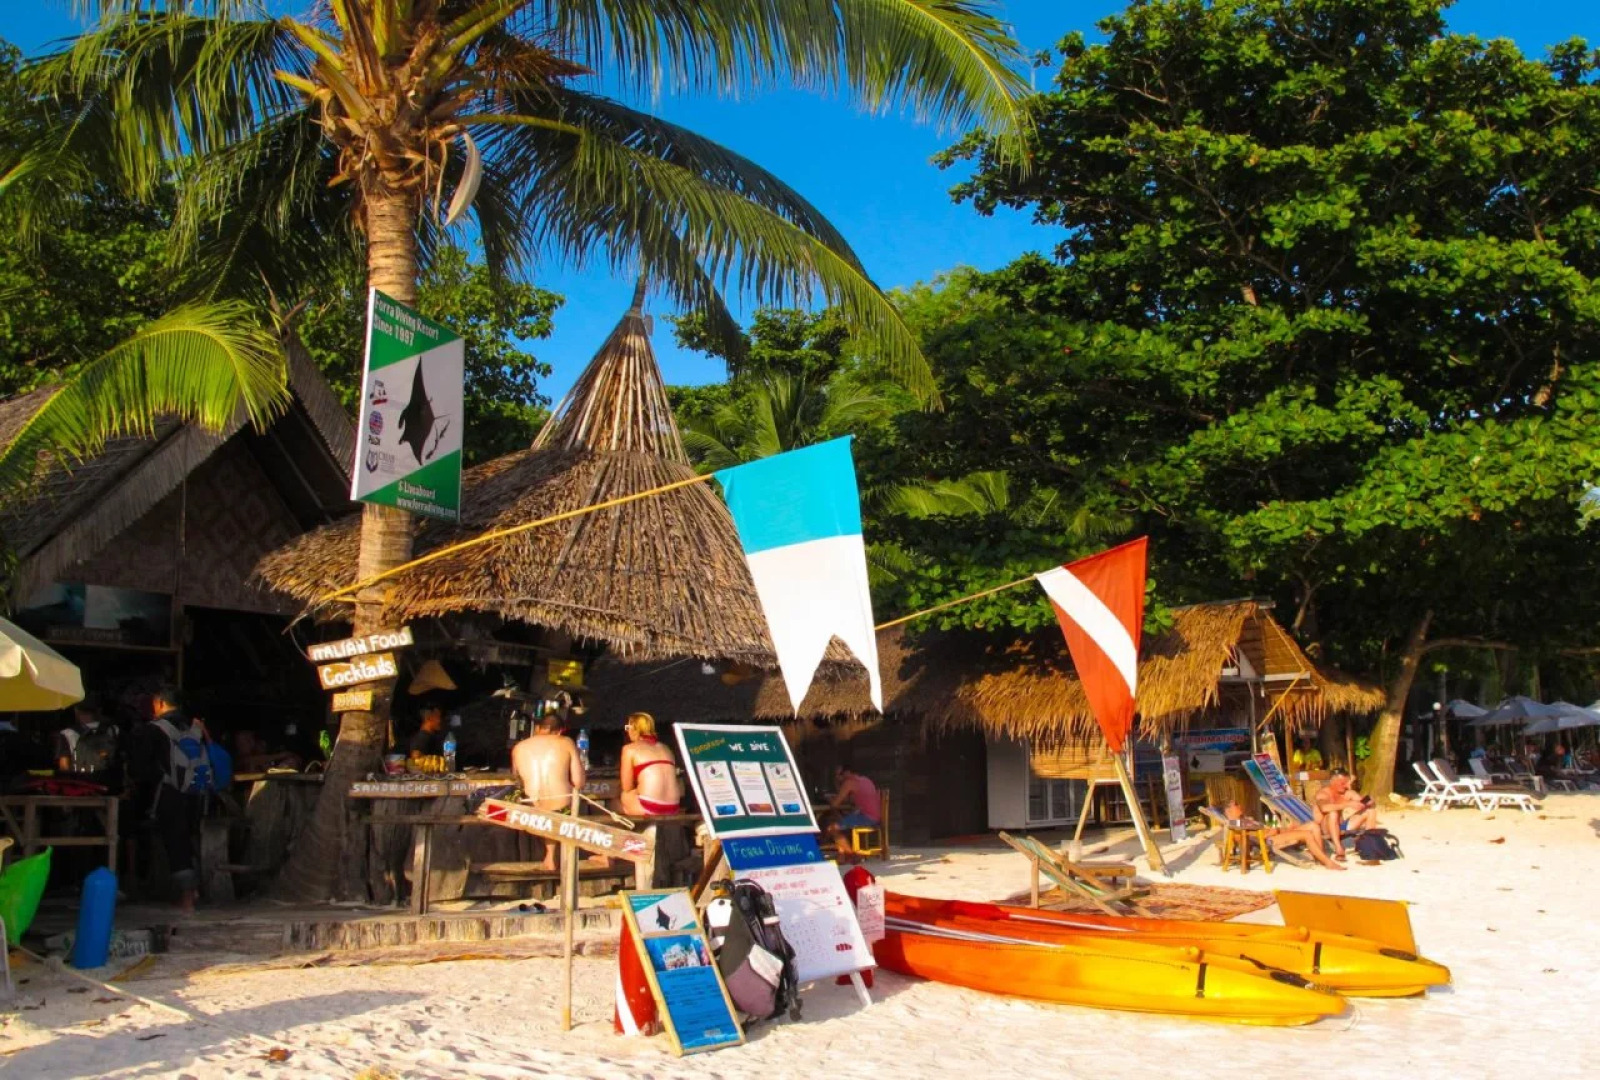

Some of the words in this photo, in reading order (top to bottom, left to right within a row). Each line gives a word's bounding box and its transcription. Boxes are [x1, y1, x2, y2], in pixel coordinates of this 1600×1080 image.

[313, 637, 369, 661] ITALIAN
[370, 631, 409, 652] FOOD
[323, 655, 395, 686] Cocktails
[729, 743, 744, 752] WE
[352, 783, 439, 793] SANDWICHES
[510, 809, 552, 831] FORRA
[560, 821, 614, 847] DIVING
